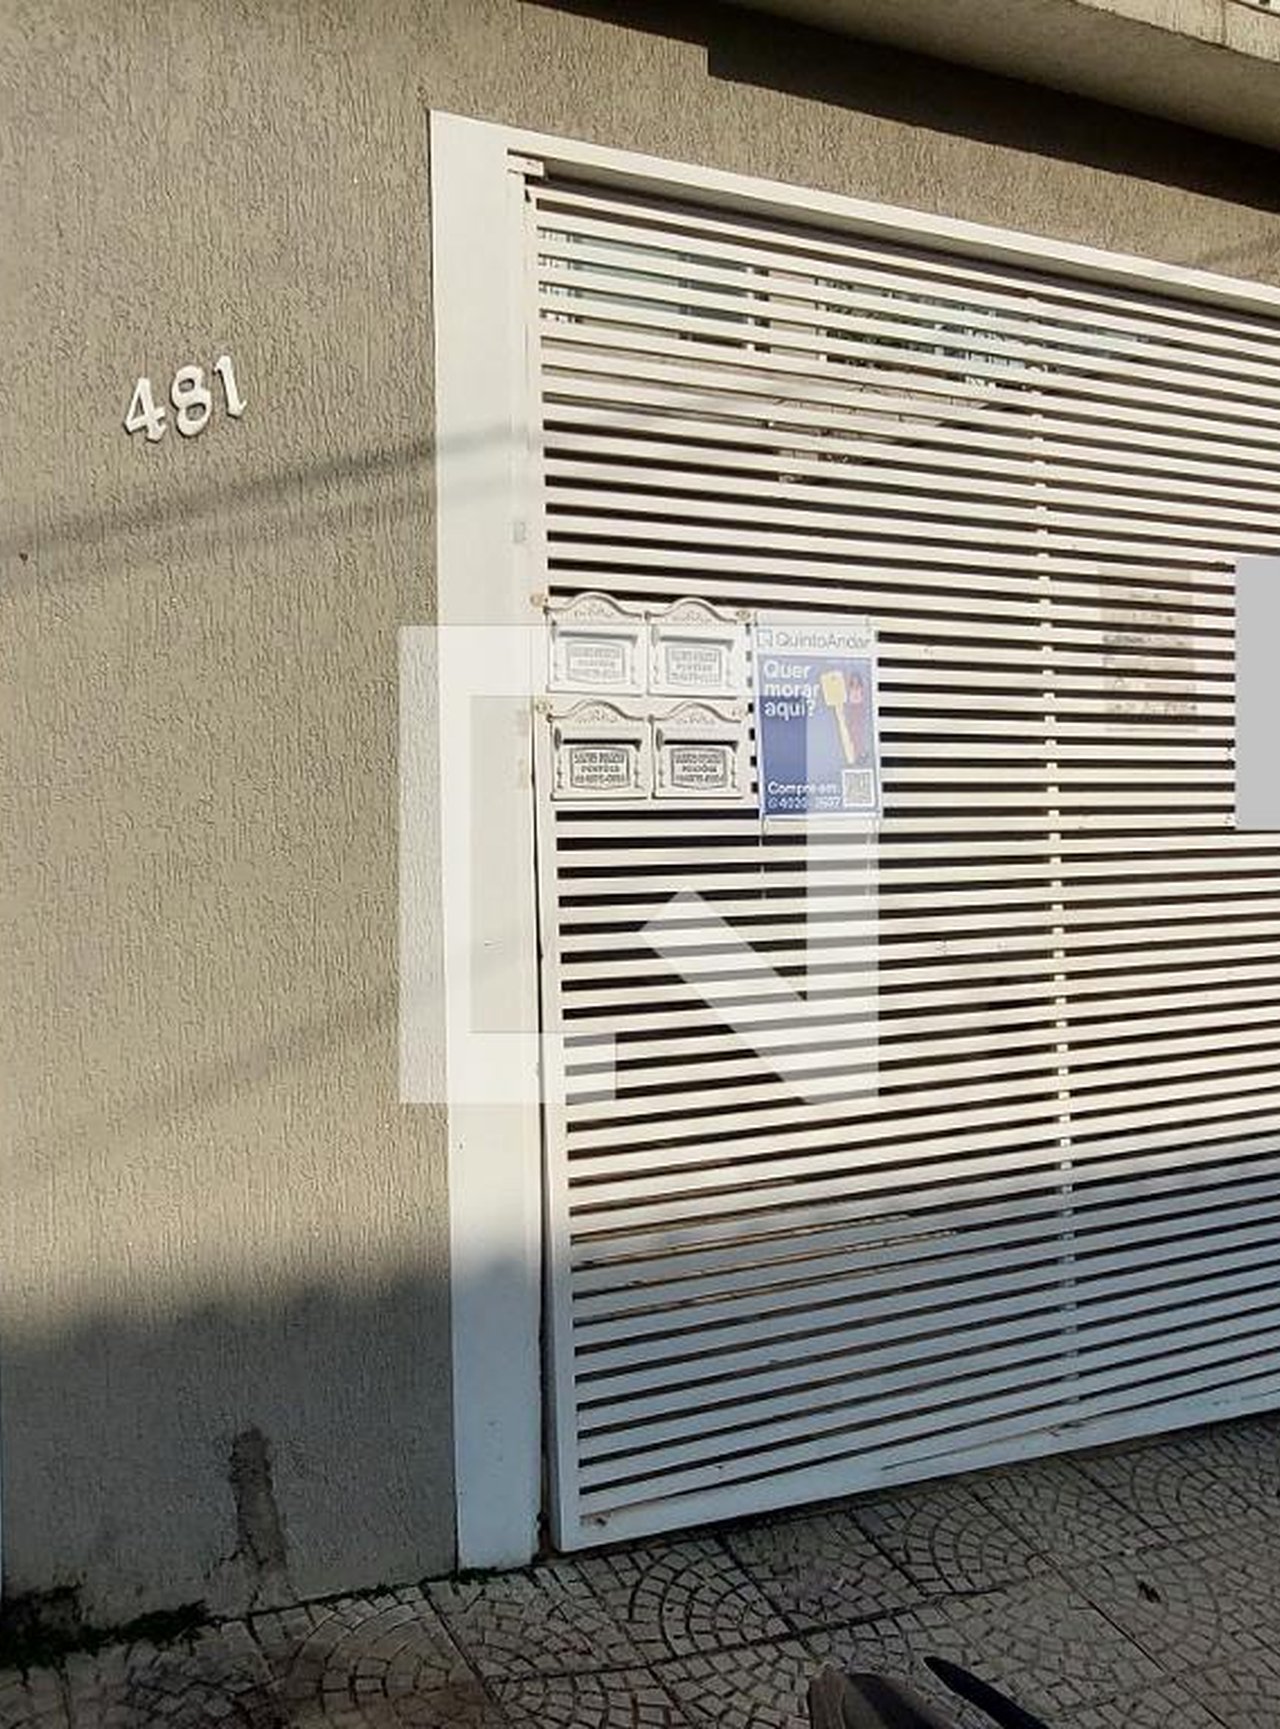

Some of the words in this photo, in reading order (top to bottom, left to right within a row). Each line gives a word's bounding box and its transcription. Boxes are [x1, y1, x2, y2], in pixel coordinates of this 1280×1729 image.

[124, 355, 247, 443] 481
[775, 628, 871, 650] QuintoAndar
[764, 660, 811, 679] Quer
[764, 682, 820, 699] morar
[764, 700, 816, 721] aqui?
